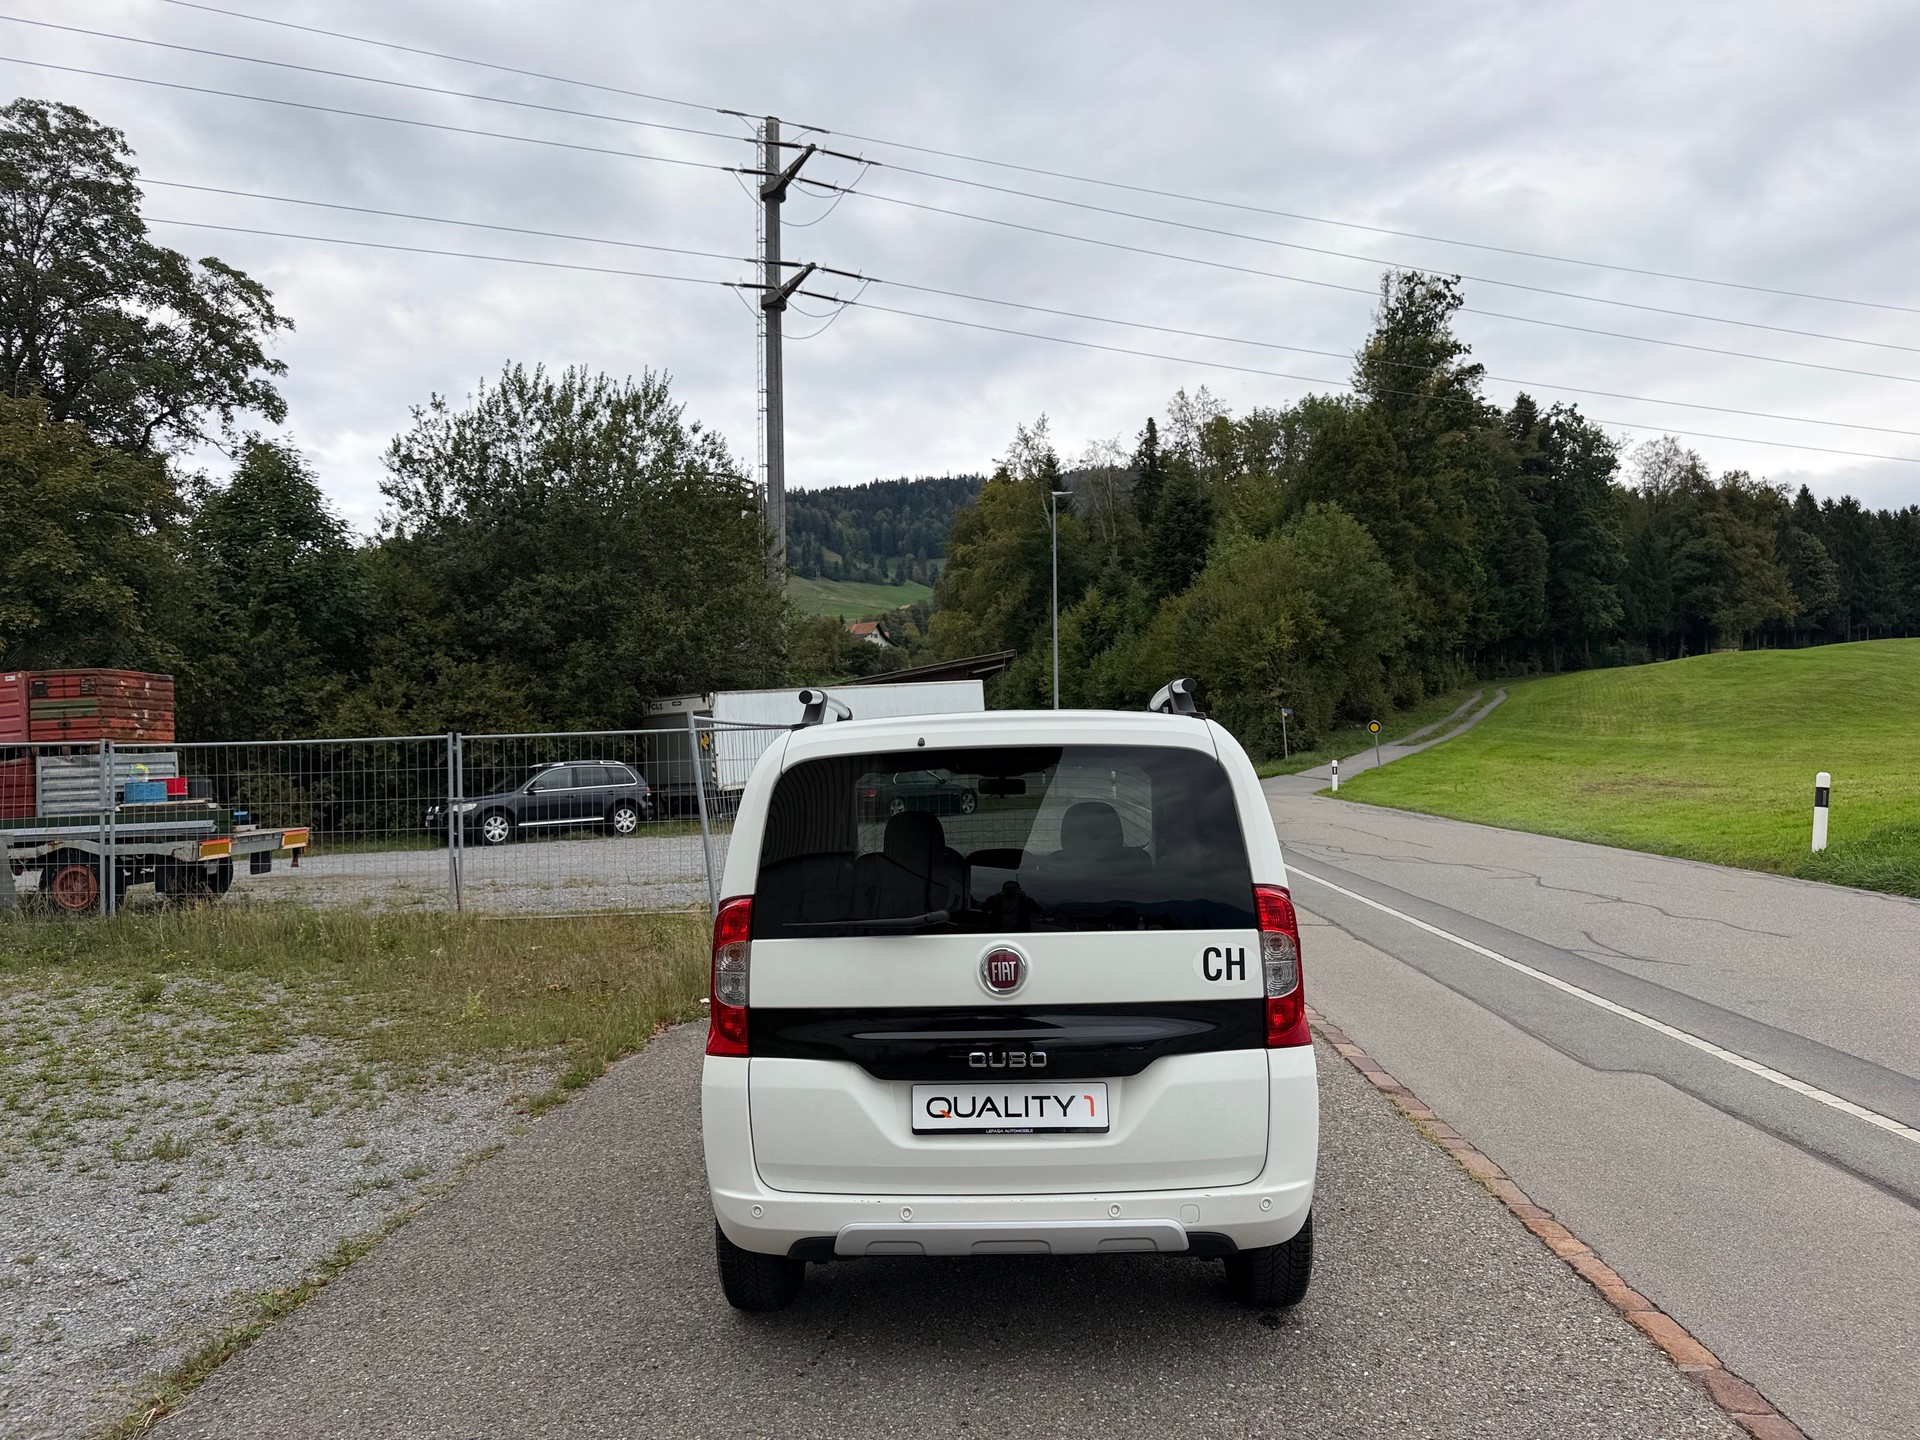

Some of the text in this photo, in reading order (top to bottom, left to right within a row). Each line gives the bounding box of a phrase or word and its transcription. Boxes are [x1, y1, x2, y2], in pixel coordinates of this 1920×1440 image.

[992, 961, 1017, 982] FIAT
[1203, 947, 1246, 981] CH
[969, 1051, 1048, 1068] QUBO
[926, 1095, 1095, 1119] QUALITY 1
